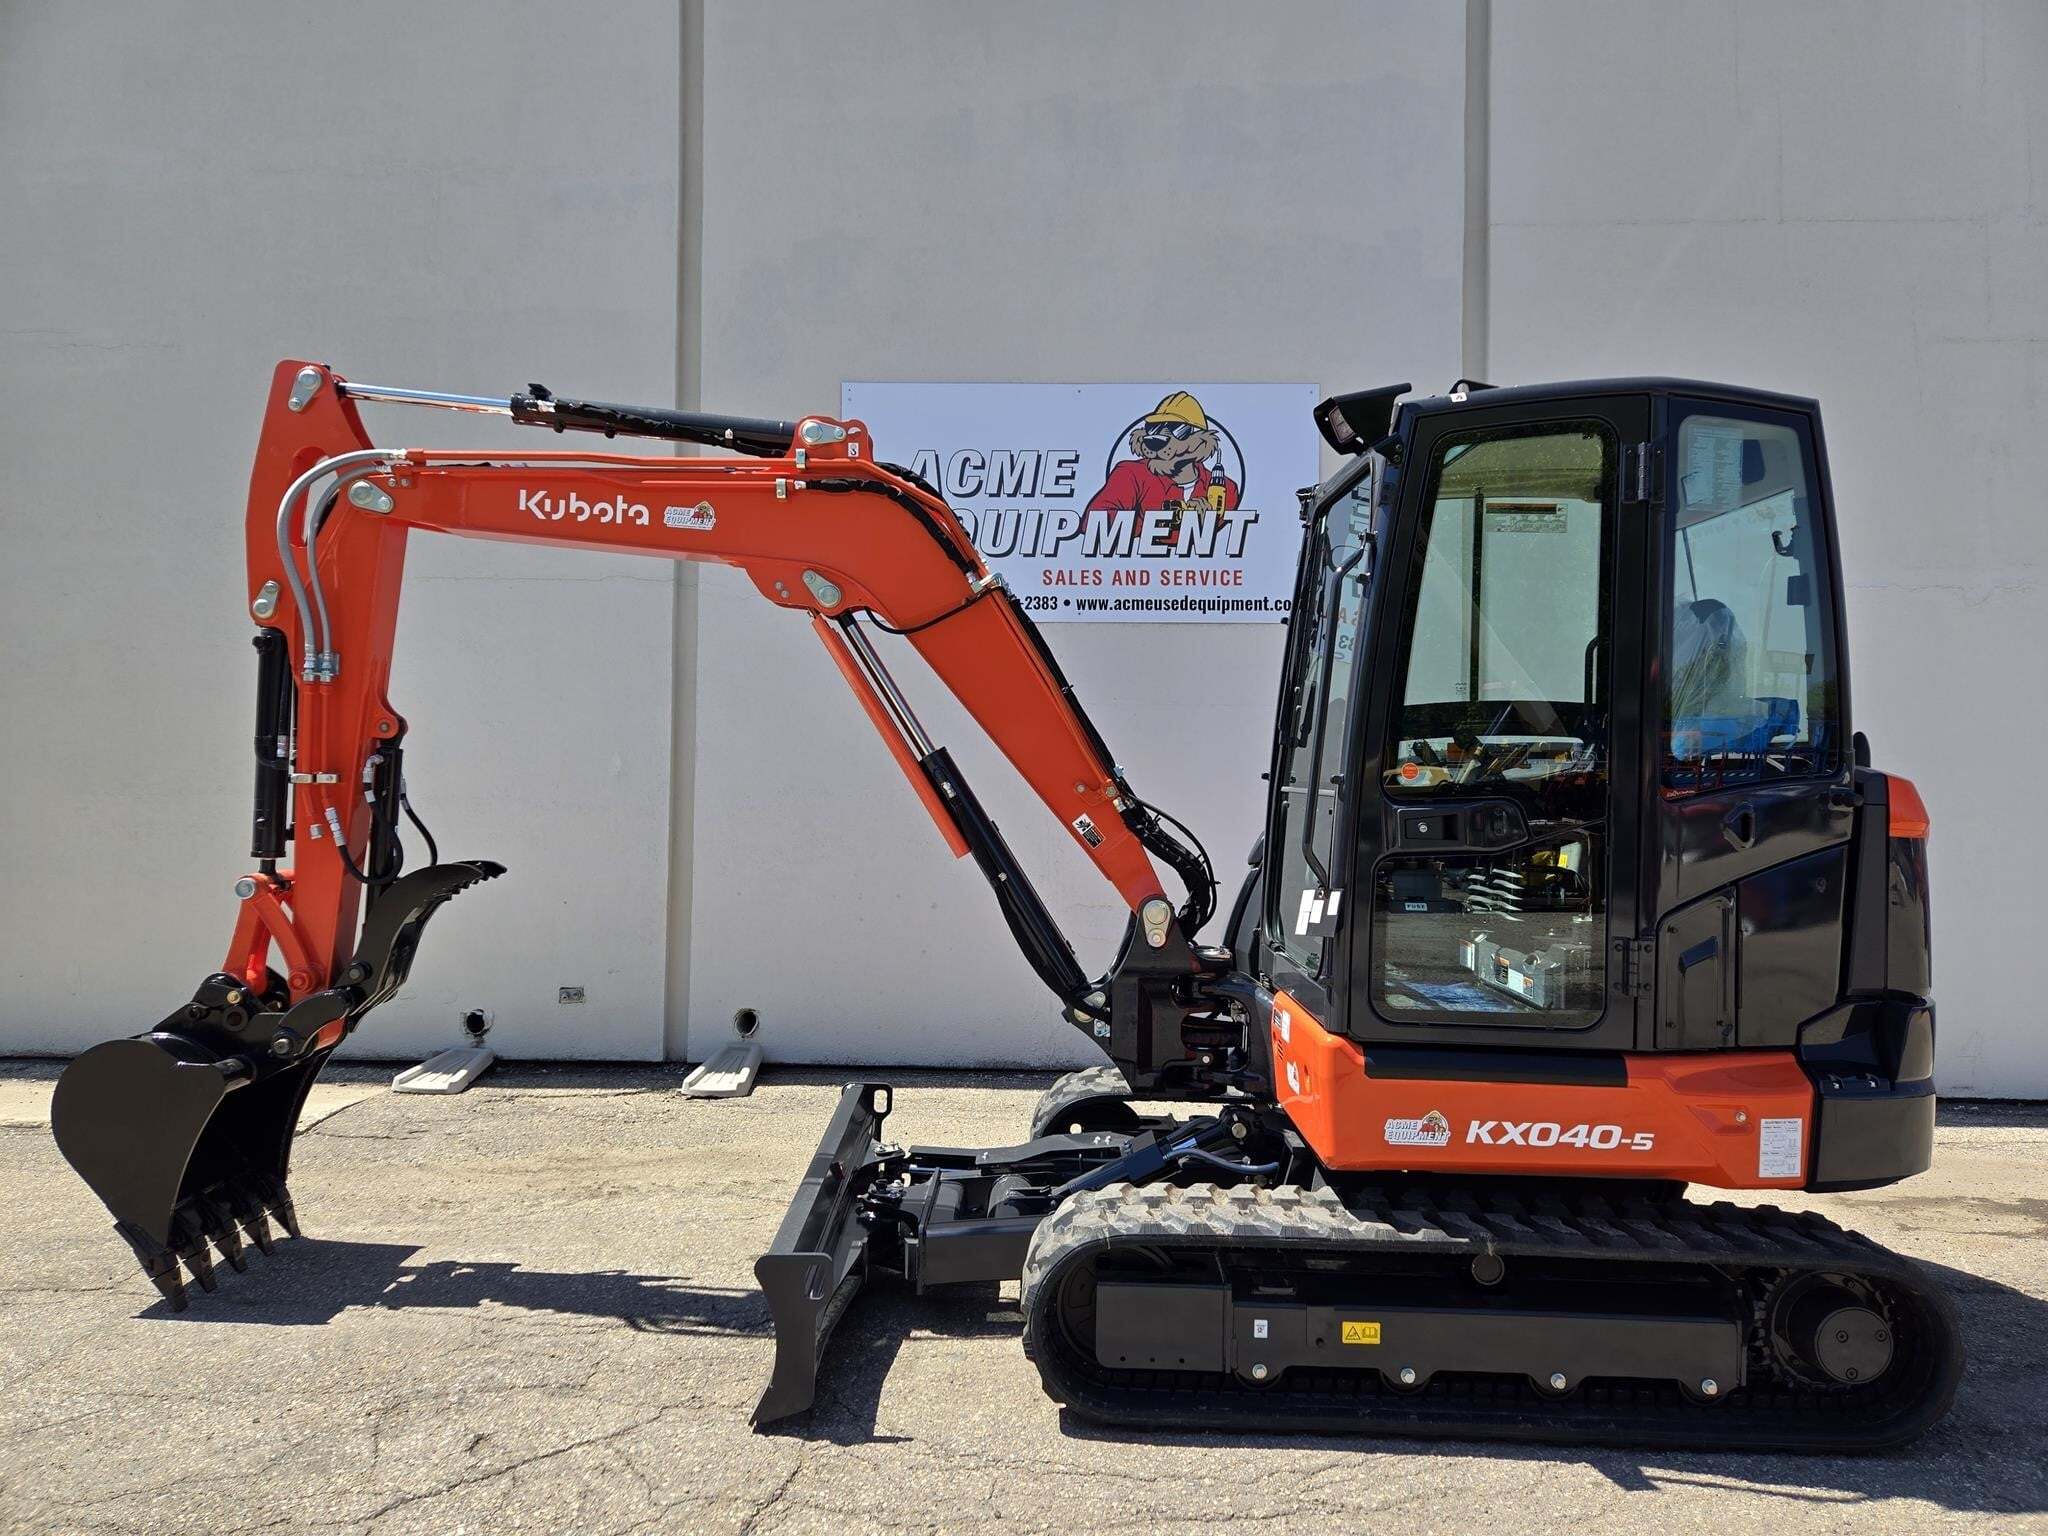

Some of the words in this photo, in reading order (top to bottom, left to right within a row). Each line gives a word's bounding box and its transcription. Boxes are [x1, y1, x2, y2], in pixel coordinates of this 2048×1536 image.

[910, 449, 1080, 497] ACME
[519, 489, 650, 526] Kubota
[951, 507, 1259, 558] QUIPMENT
[1042, 569, 1102, 586] SALES
[1112, 570, 1150, 586] AND
[1160, 570, 1243, 586] SERVICE
[1076, 595, 1292, 615] www.acmeusedequipment.co
[1387, 1120, 1419, 1130] ACME
[1386, 1130, 1450, 1141] EQUIPMENT
